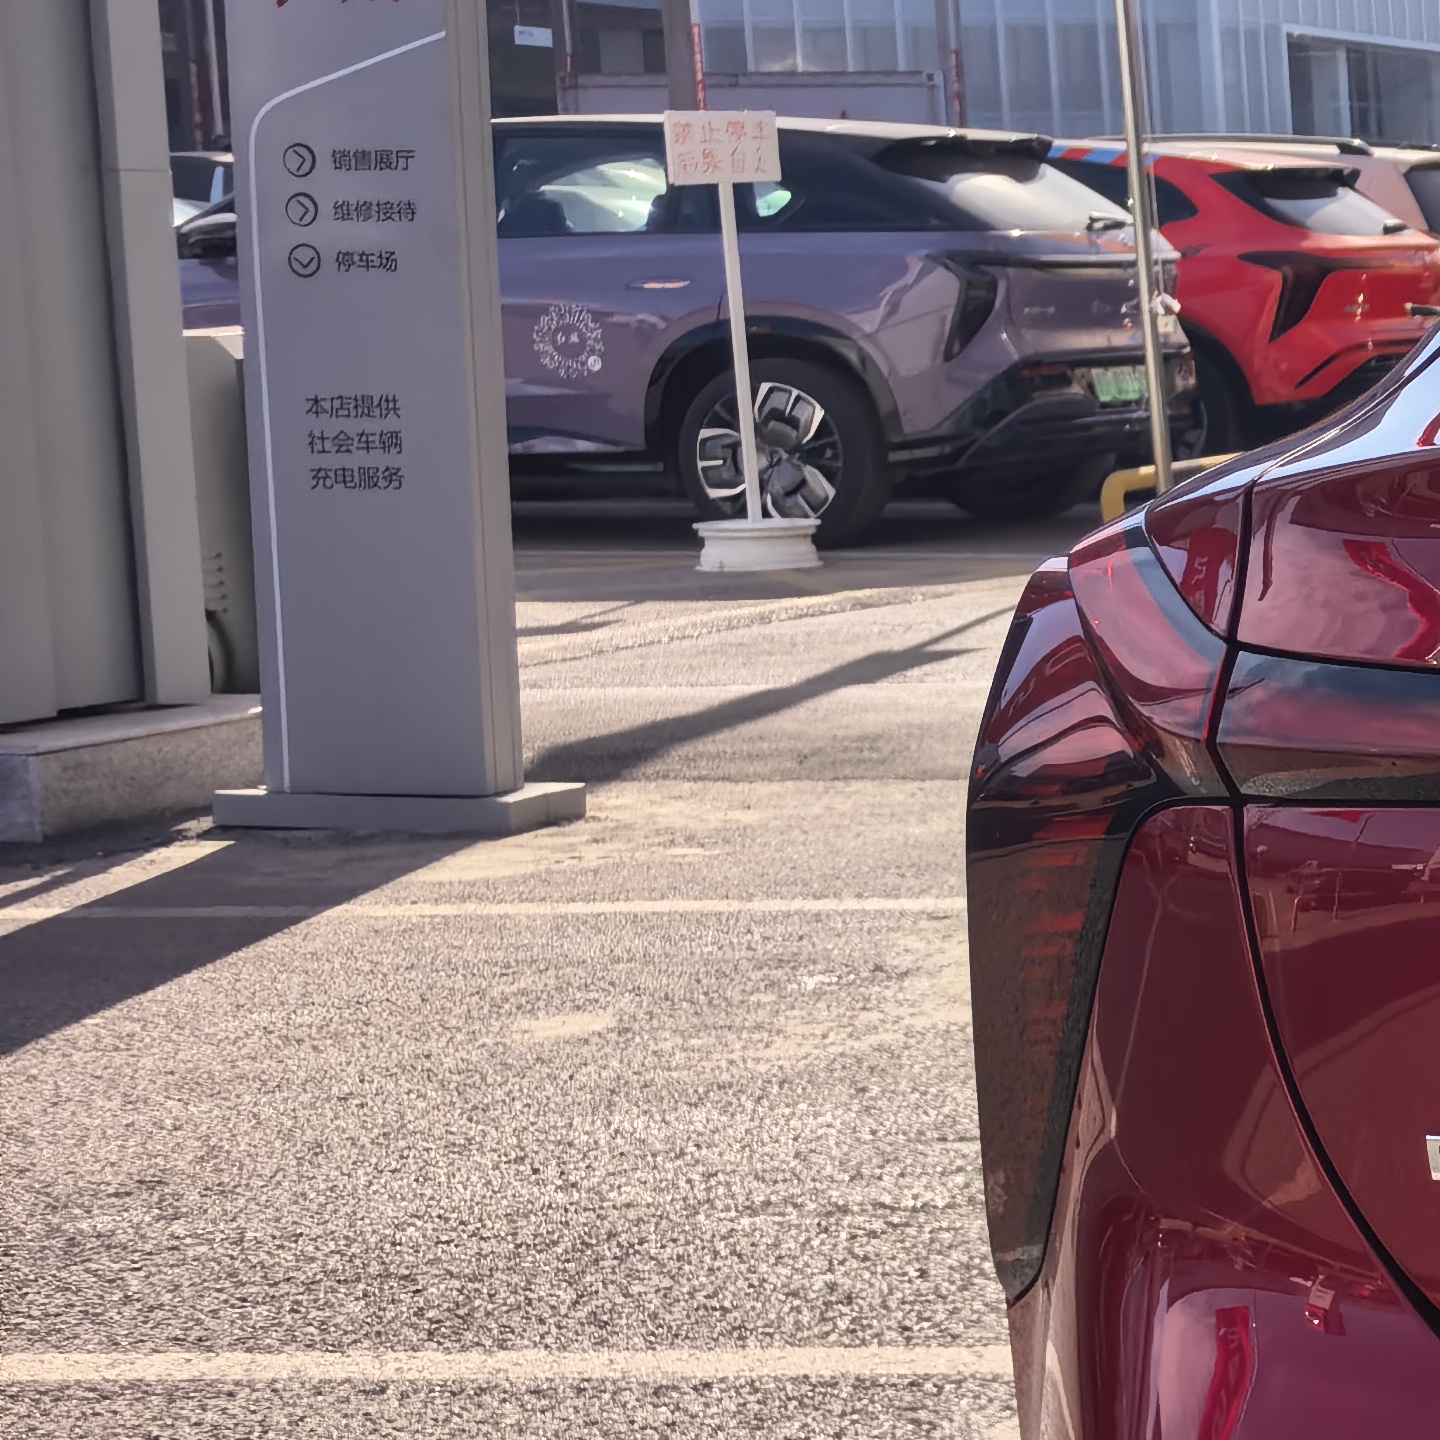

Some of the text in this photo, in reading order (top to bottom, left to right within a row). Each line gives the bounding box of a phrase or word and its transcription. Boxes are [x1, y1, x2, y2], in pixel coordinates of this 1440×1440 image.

[331, 148, 415, 172] 销售展厅
[333, 199, 417, 223] 维修接待
[335, 250, 398, 273] 停车场
[305, 393, 401, 420] 本店提供
[308, 429, 403, 455] 社会车辆
[310, 465, 405, 491] 充电服务
